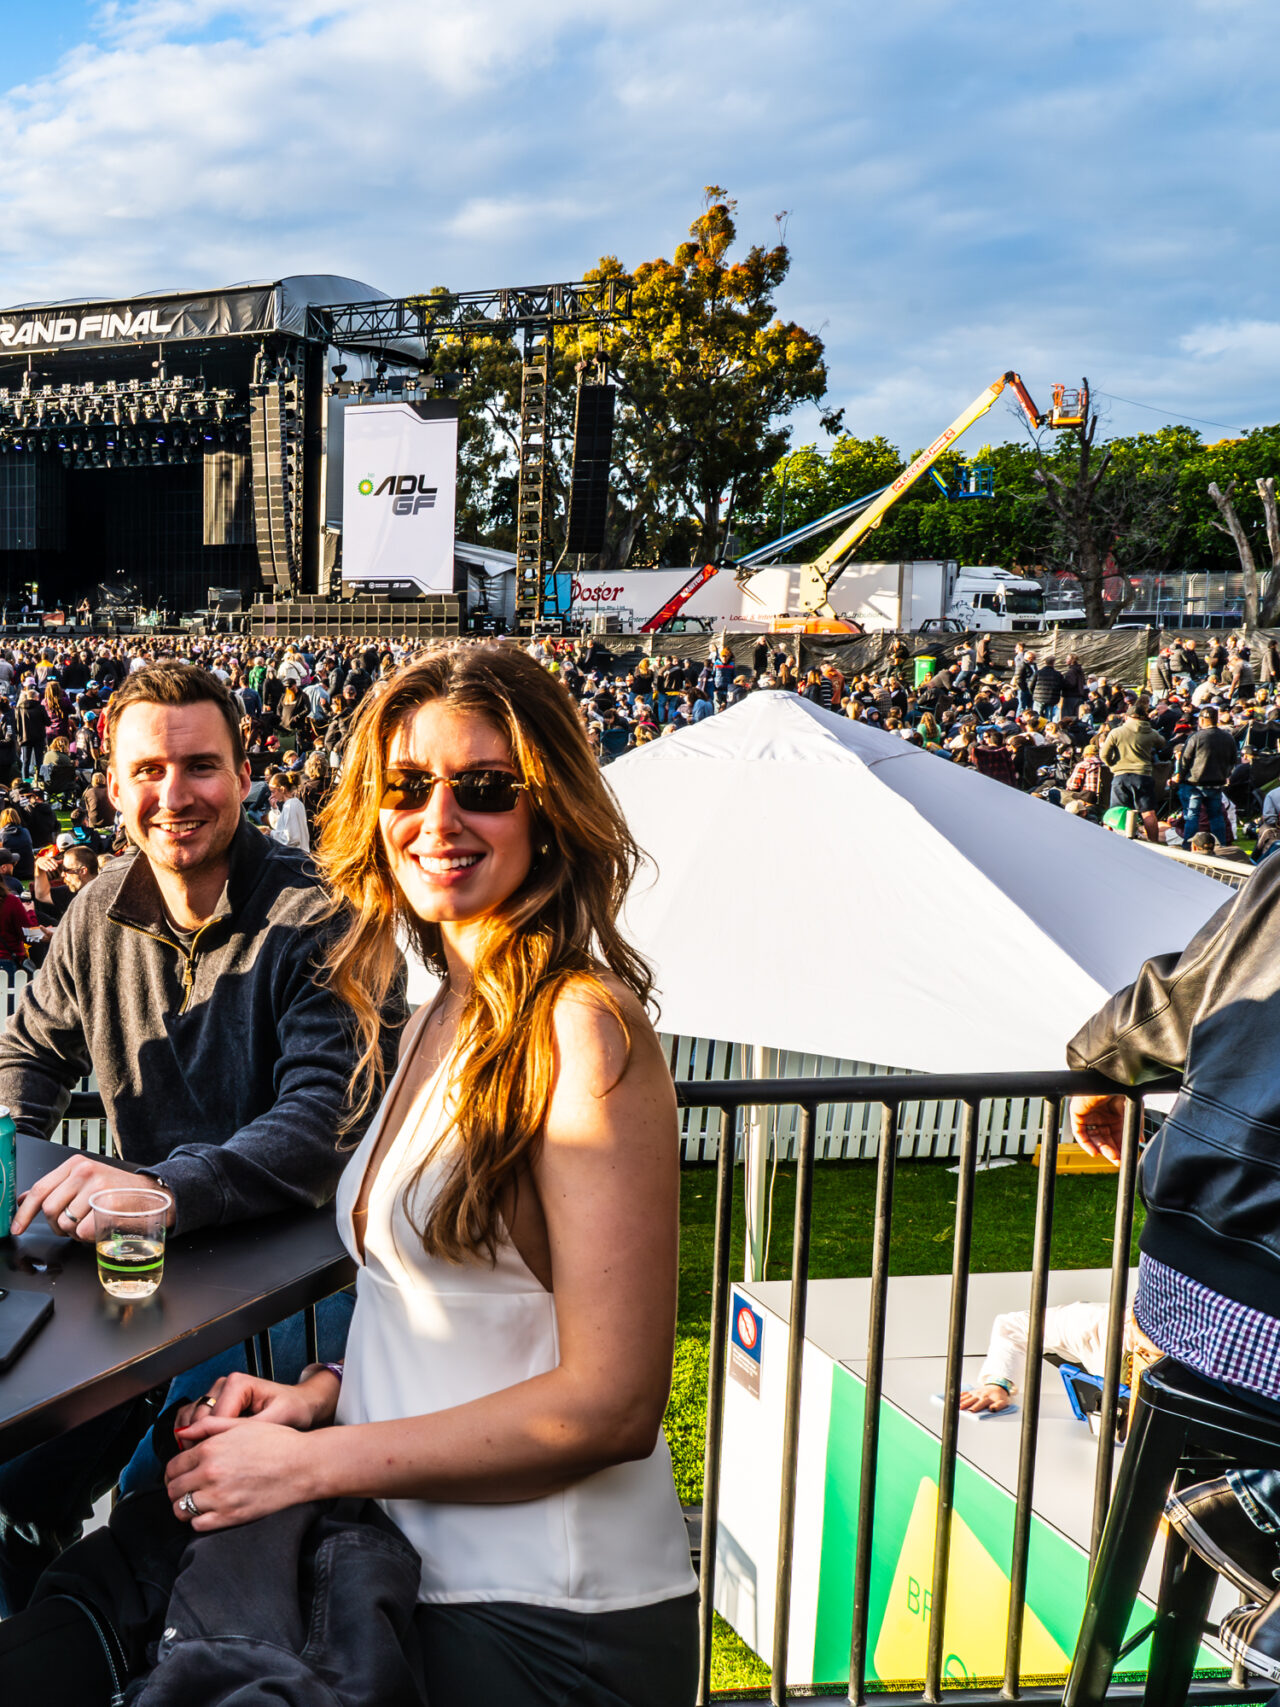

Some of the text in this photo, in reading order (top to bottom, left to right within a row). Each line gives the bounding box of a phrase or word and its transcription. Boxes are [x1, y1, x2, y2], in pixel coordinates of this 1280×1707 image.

[78, 310, 171, 340] FINAL
[373, 474, 438, 496] ADL
[392, 495, 437, 516] GF
